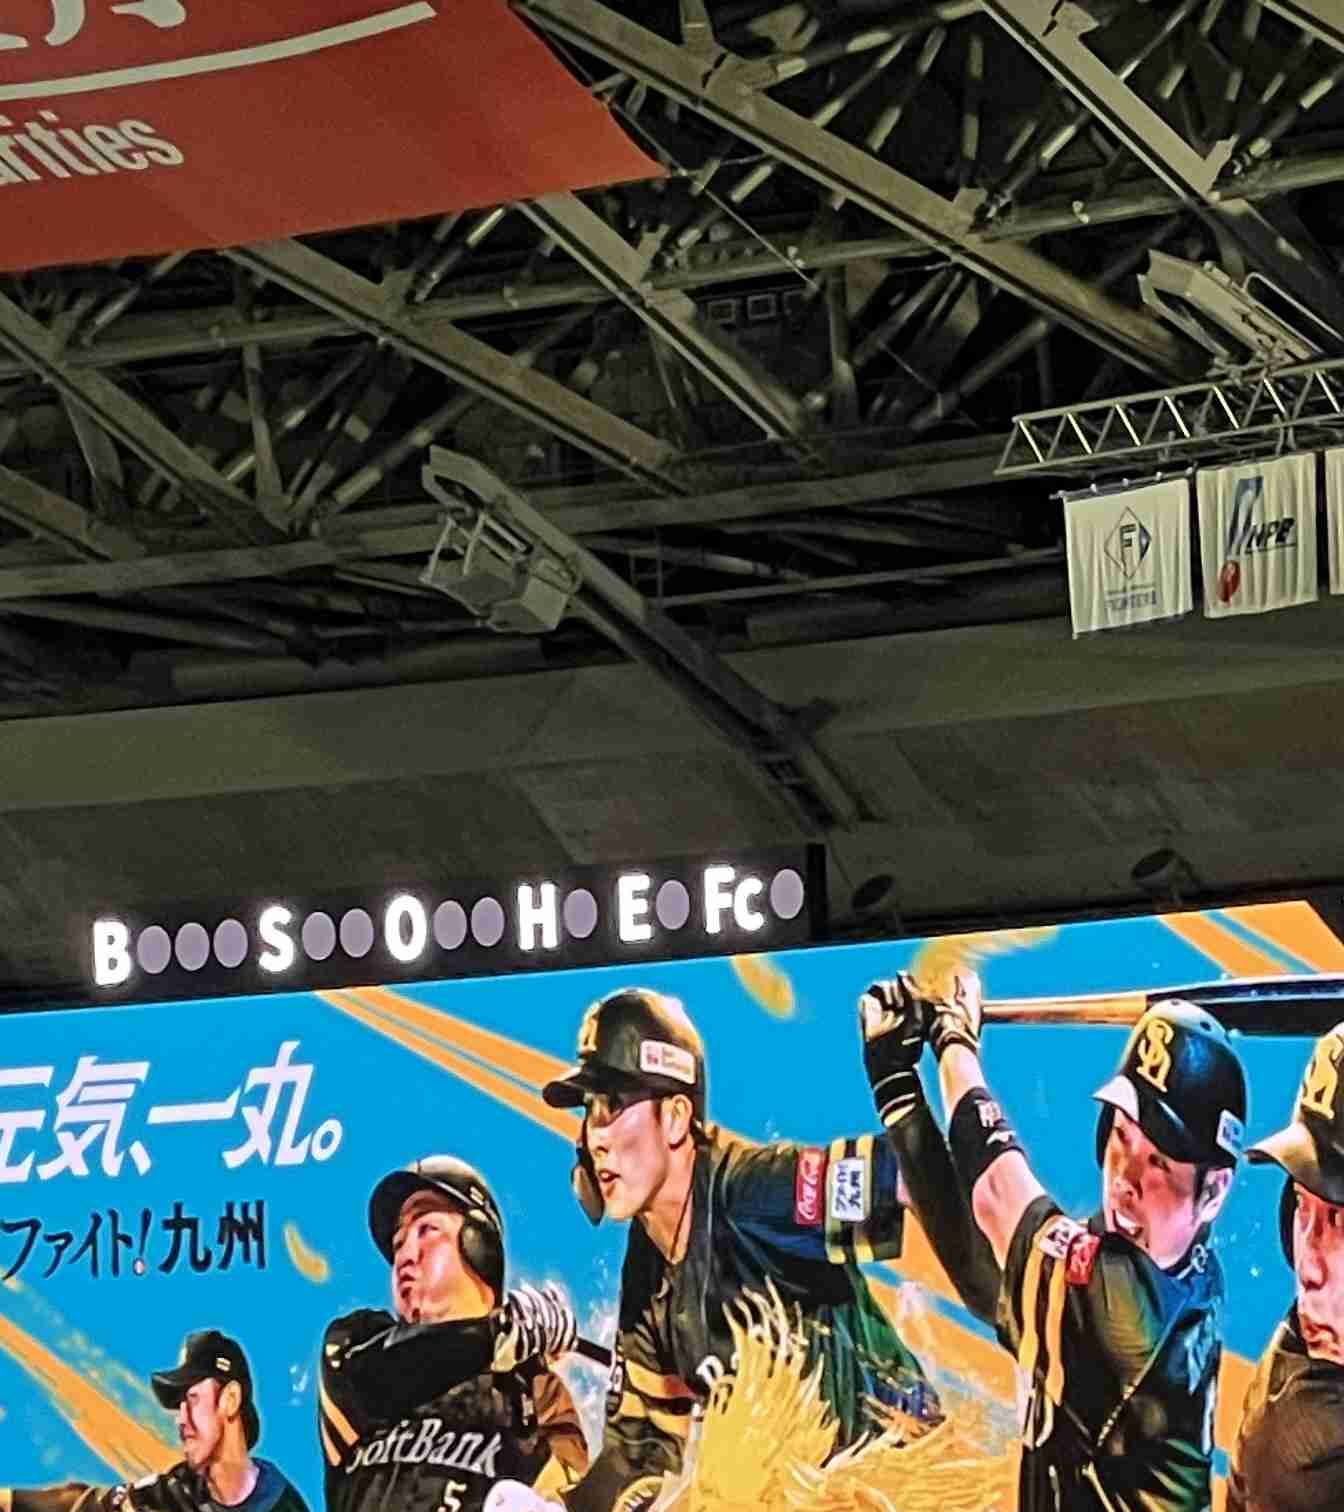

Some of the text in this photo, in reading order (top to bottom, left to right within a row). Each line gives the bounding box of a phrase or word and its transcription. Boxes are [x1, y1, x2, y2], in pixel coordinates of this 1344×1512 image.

[92, 919, 132, 986] B
[257, 906, 296, 972] S
[384, 895, 428, 963] O
[516, 883, 557, 950] H
[617, 873, 652, 942] E
